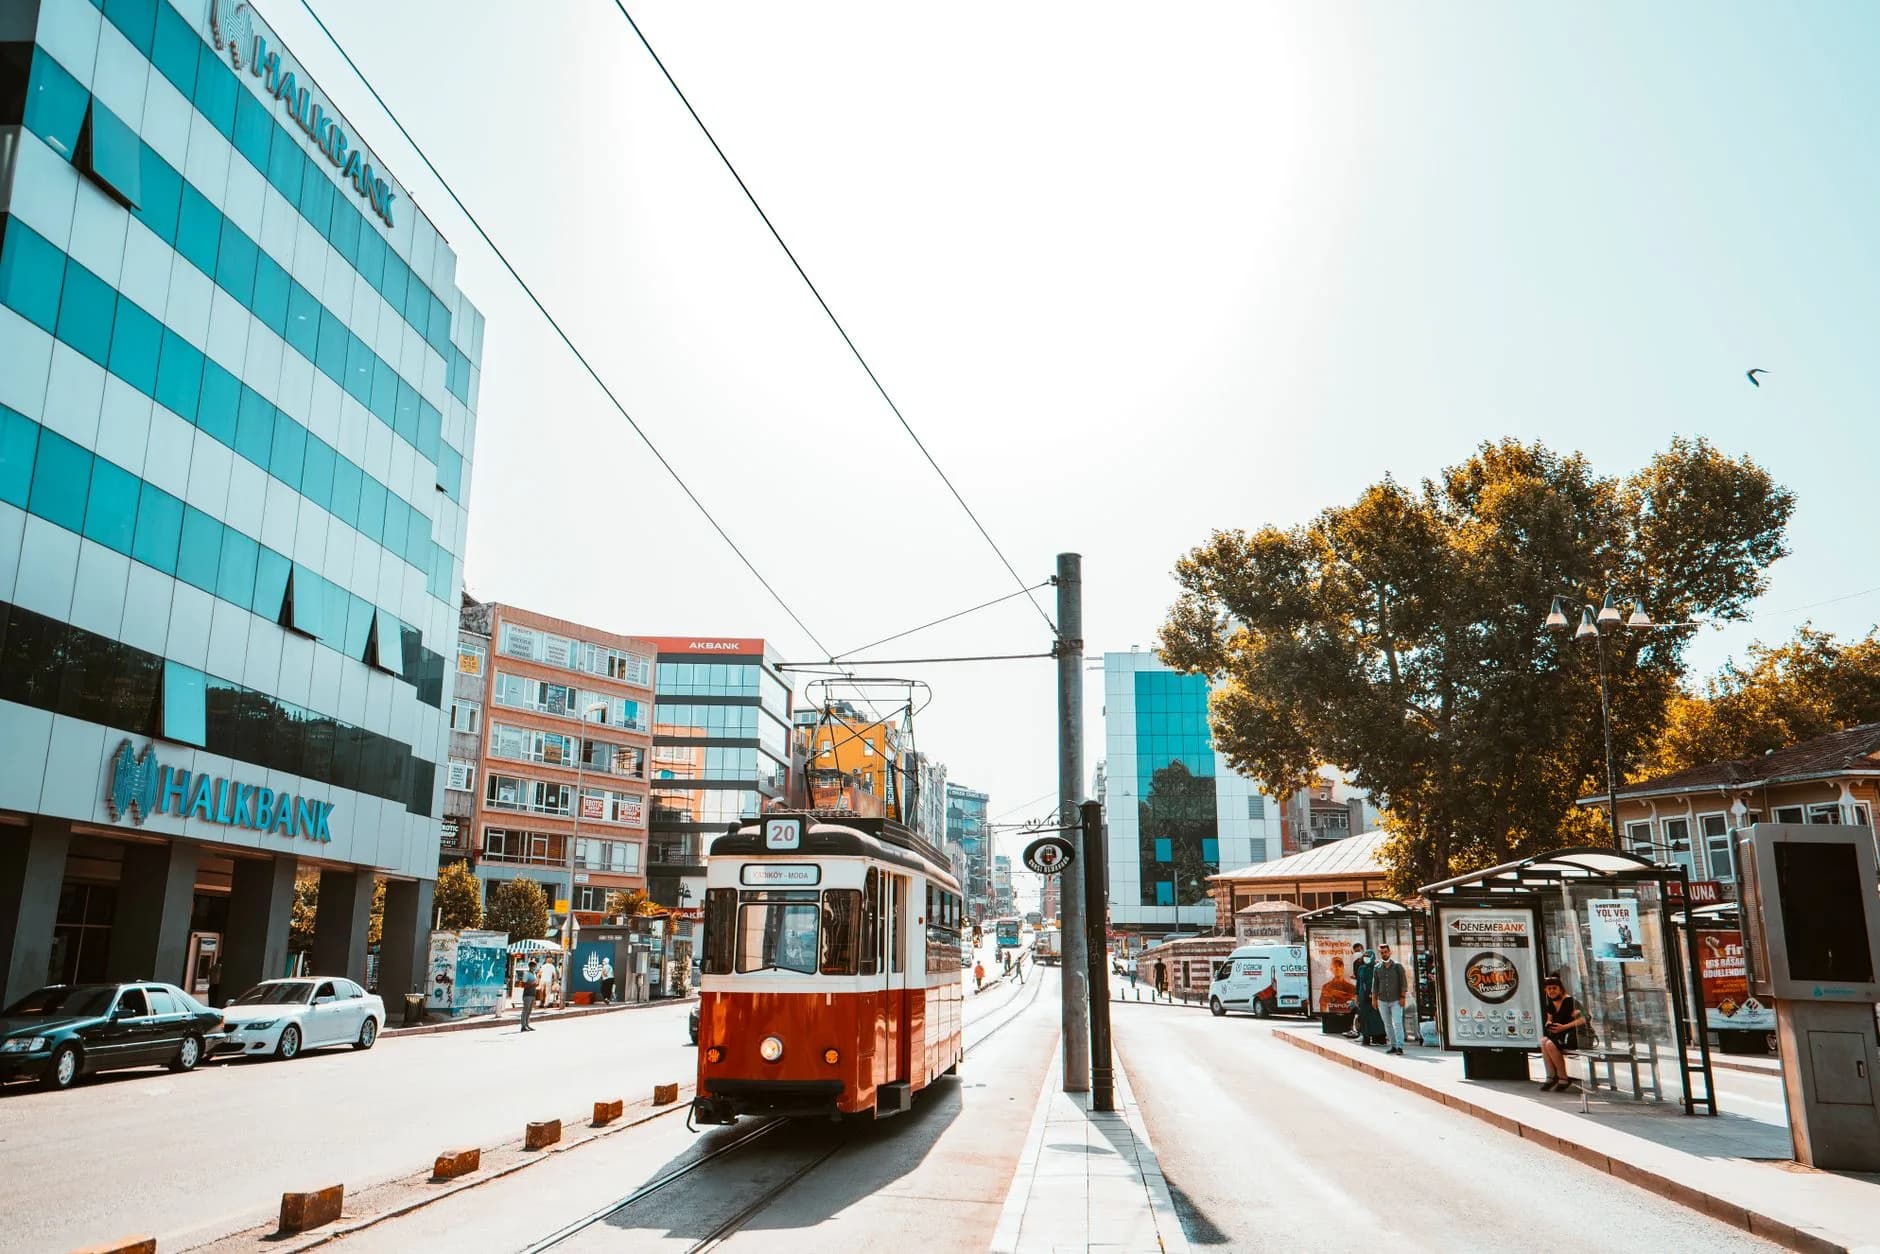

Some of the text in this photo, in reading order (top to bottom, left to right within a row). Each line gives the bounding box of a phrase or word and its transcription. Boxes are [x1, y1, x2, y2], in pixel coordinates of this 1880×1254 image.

[251, 34, 397, 229] HALKBANK
[688, 641, 740, 650] AKBANK
[158, 763, 335, 844] HALKBANK
[771, 825, 796, 842] 20
[682, 911, 705, 919] AKB
[1595, 908, 1630, 917] YOL VER
[1460, 923, 1525, 932] DENEMEBANK
